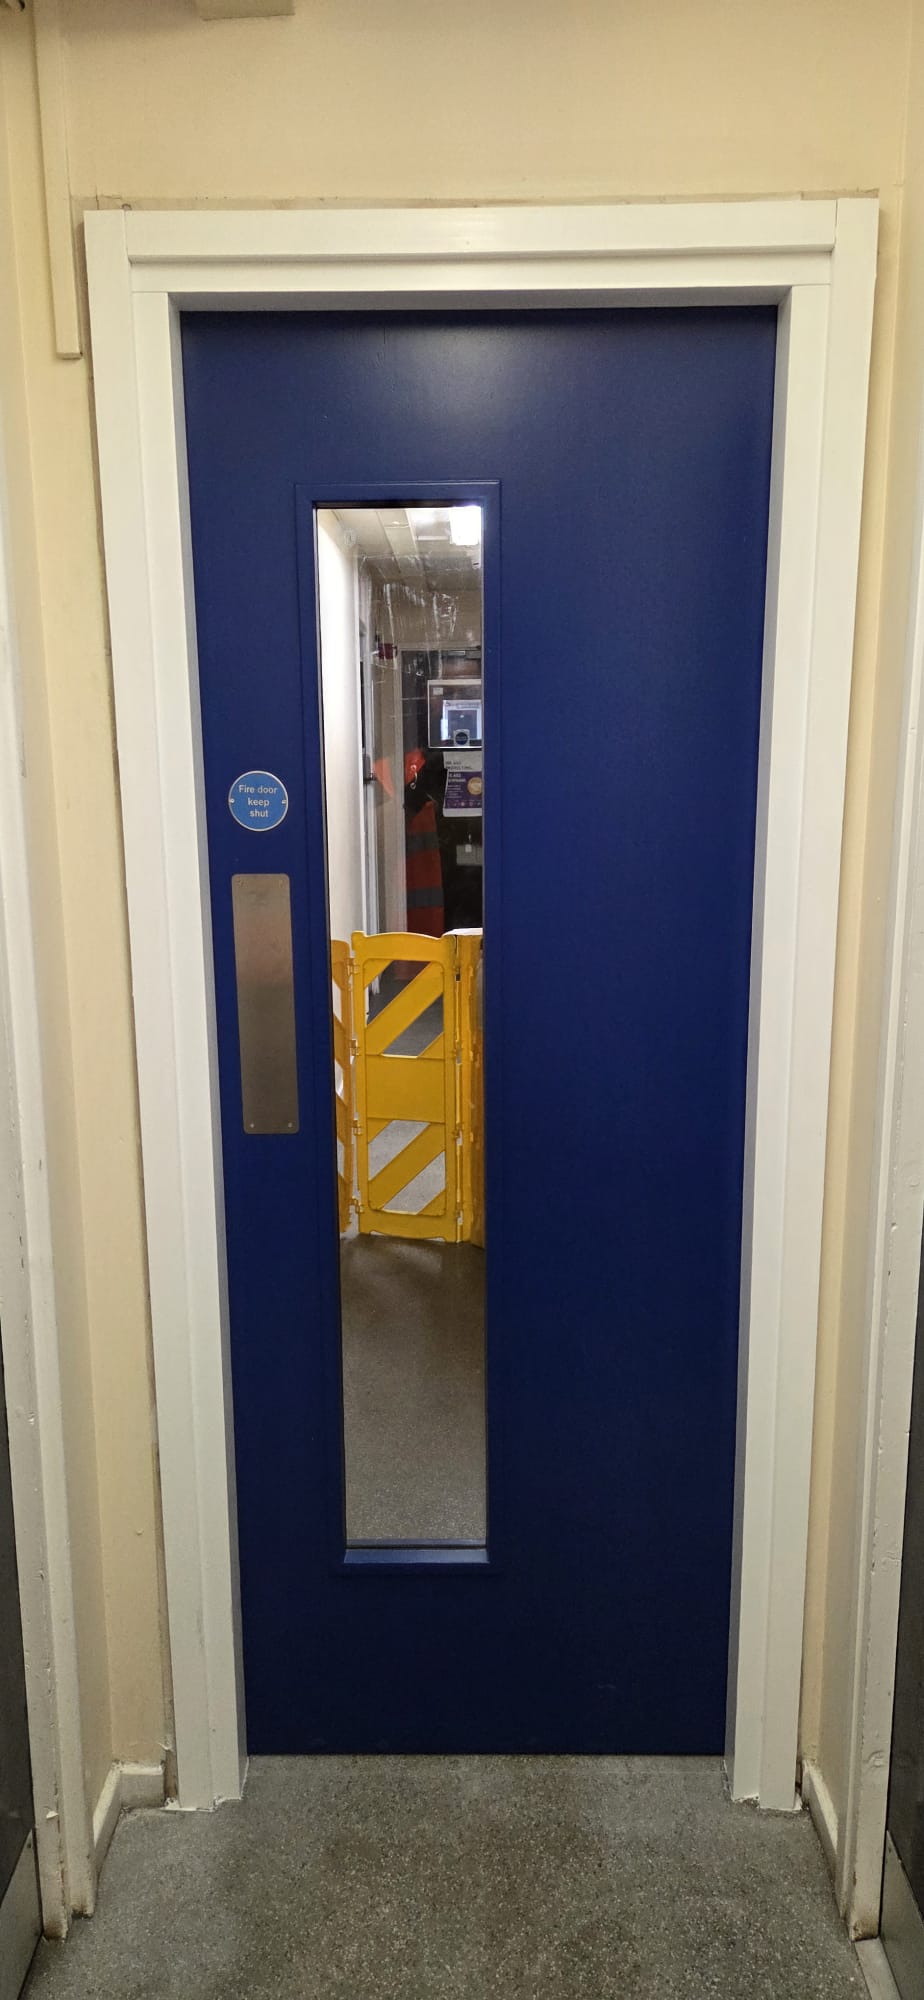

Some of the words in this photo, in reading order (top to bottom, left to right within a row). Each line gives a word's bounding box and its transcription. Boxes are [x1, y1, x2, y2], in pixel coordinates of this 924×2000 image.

[238, 784, 255, 793] Fire
[257, 785, 278, 794] door
[247, 797, 270, 807] keep
[249, 808, 269, 818] shut
